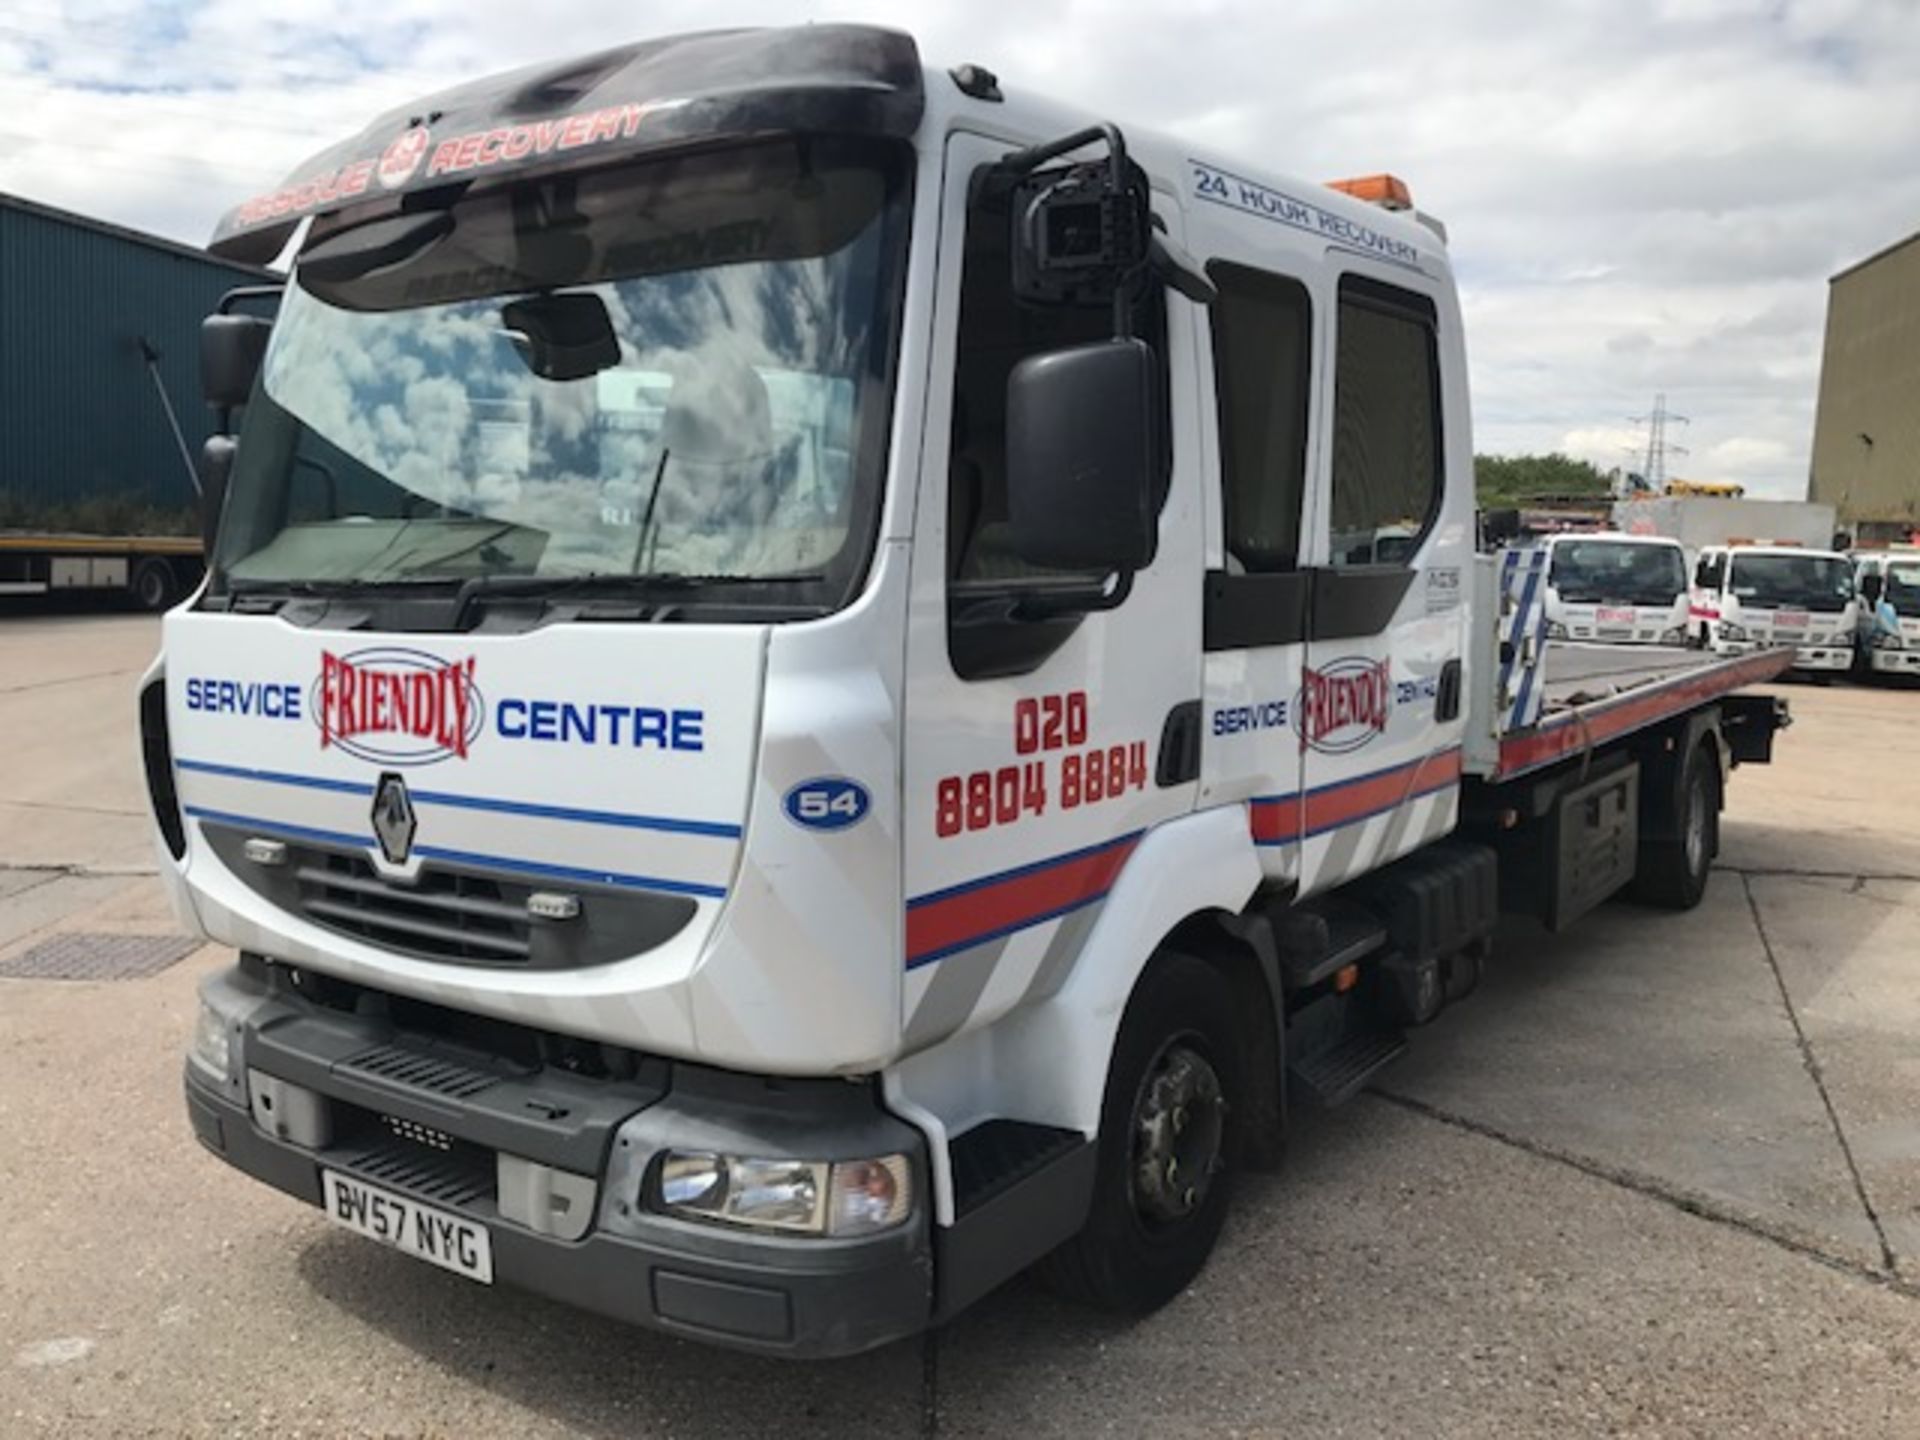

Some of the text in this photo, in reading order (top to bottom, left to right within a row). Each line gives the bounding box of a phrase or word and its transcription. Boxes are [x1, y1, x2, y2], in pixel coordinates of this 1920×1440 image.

[426, 104, 653, 177] RECOVERY
[1194, 169, 1418, 261] 24 HOUR RECOVERY
[187, 649, 704, 760] SERVICE FRIENDLY CENTRE
[1015, 691, 1088, 756] 020
[1213, 701, 1287, 736] SERVICE
[1300, 655, 1391, 755] FRIENDLY
[799, 791, 859, 817] 54
[935, 741, 1148, 839] 8804 8884
[335, 1181, 478, 1270] BV57 NYG
